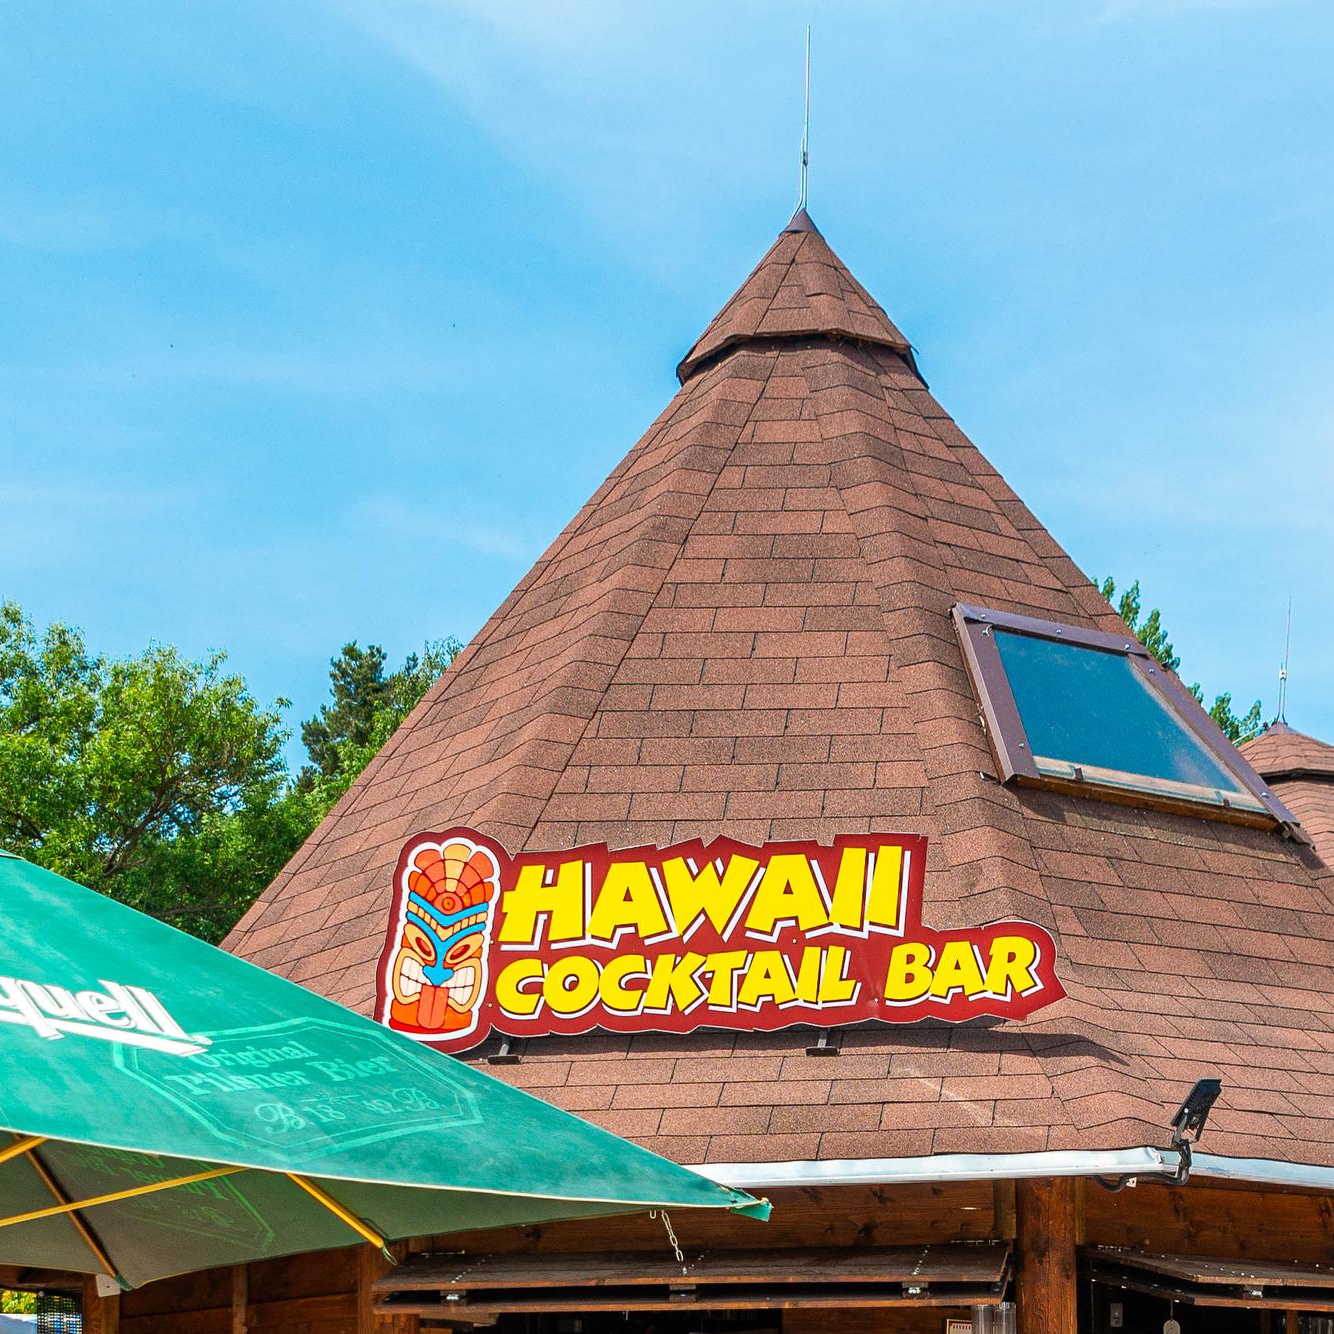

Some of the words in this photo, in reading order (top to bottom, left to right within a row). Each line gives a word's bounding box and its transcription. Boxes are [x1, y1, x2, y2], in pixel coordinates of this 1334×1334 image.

[499, 845, 907, 948] HAWAII
[495, 944, 859, 1017] COCKTAIL
[882, 936, 1041, 1005] BAR
[164, 1069, 307, 1096] Pilsner
[316, 1055, 399, 1082] Bier
[189, 1040, 318, 1070] Original
